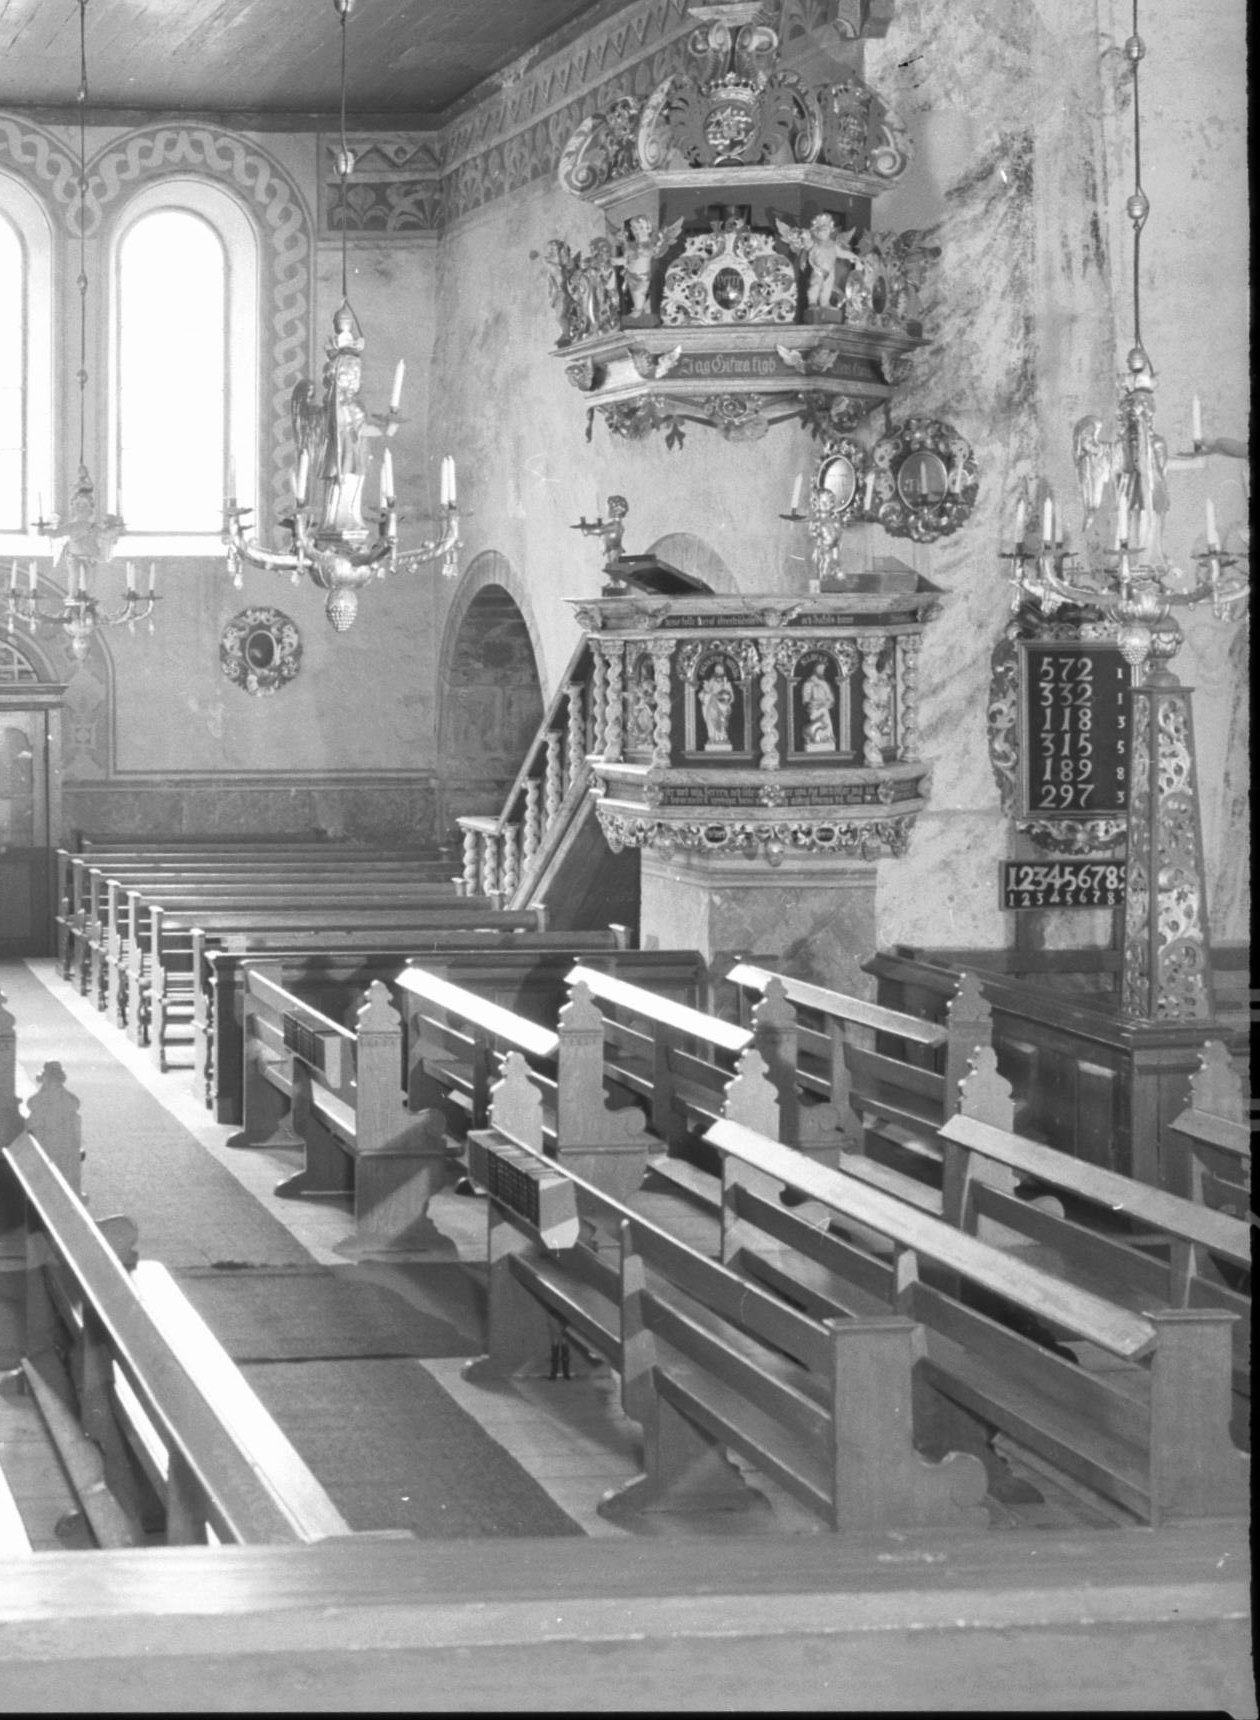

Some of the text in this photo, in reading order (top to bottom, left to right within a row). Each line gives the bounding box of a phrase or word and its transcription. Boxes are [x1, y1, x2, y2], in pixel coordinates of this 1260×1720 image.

[1040, 656, 1123, 682] 572 1
[1039, 682, 1123, 707] 332 1
[1042, 707, 1126, 731] 118 3
[1040, 732, 1125, 757] 315 5
[1042, 758, 1125, 782] 189 8
[1038, 783, 1125, 809] 297 3
